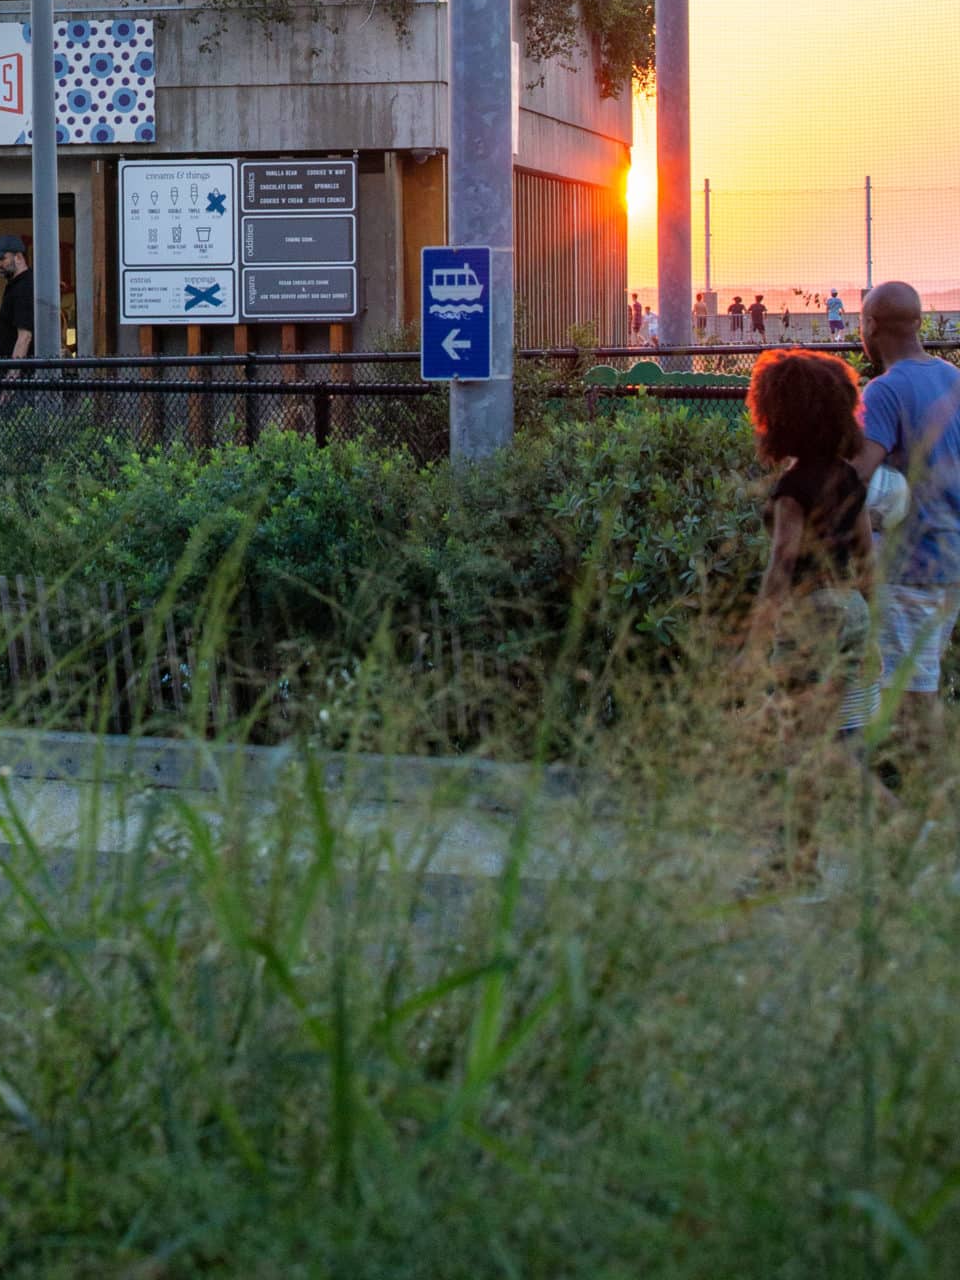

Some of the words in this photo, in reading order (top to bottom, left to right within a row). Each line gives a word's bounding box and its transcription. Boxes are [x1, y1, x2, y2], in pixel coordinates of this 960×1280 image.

[145, 173, 175, 181] creams
[186, 170, 210, 181] things
[247, 172, 256, 203] classics
[246, 223, 254, 257] oddities
